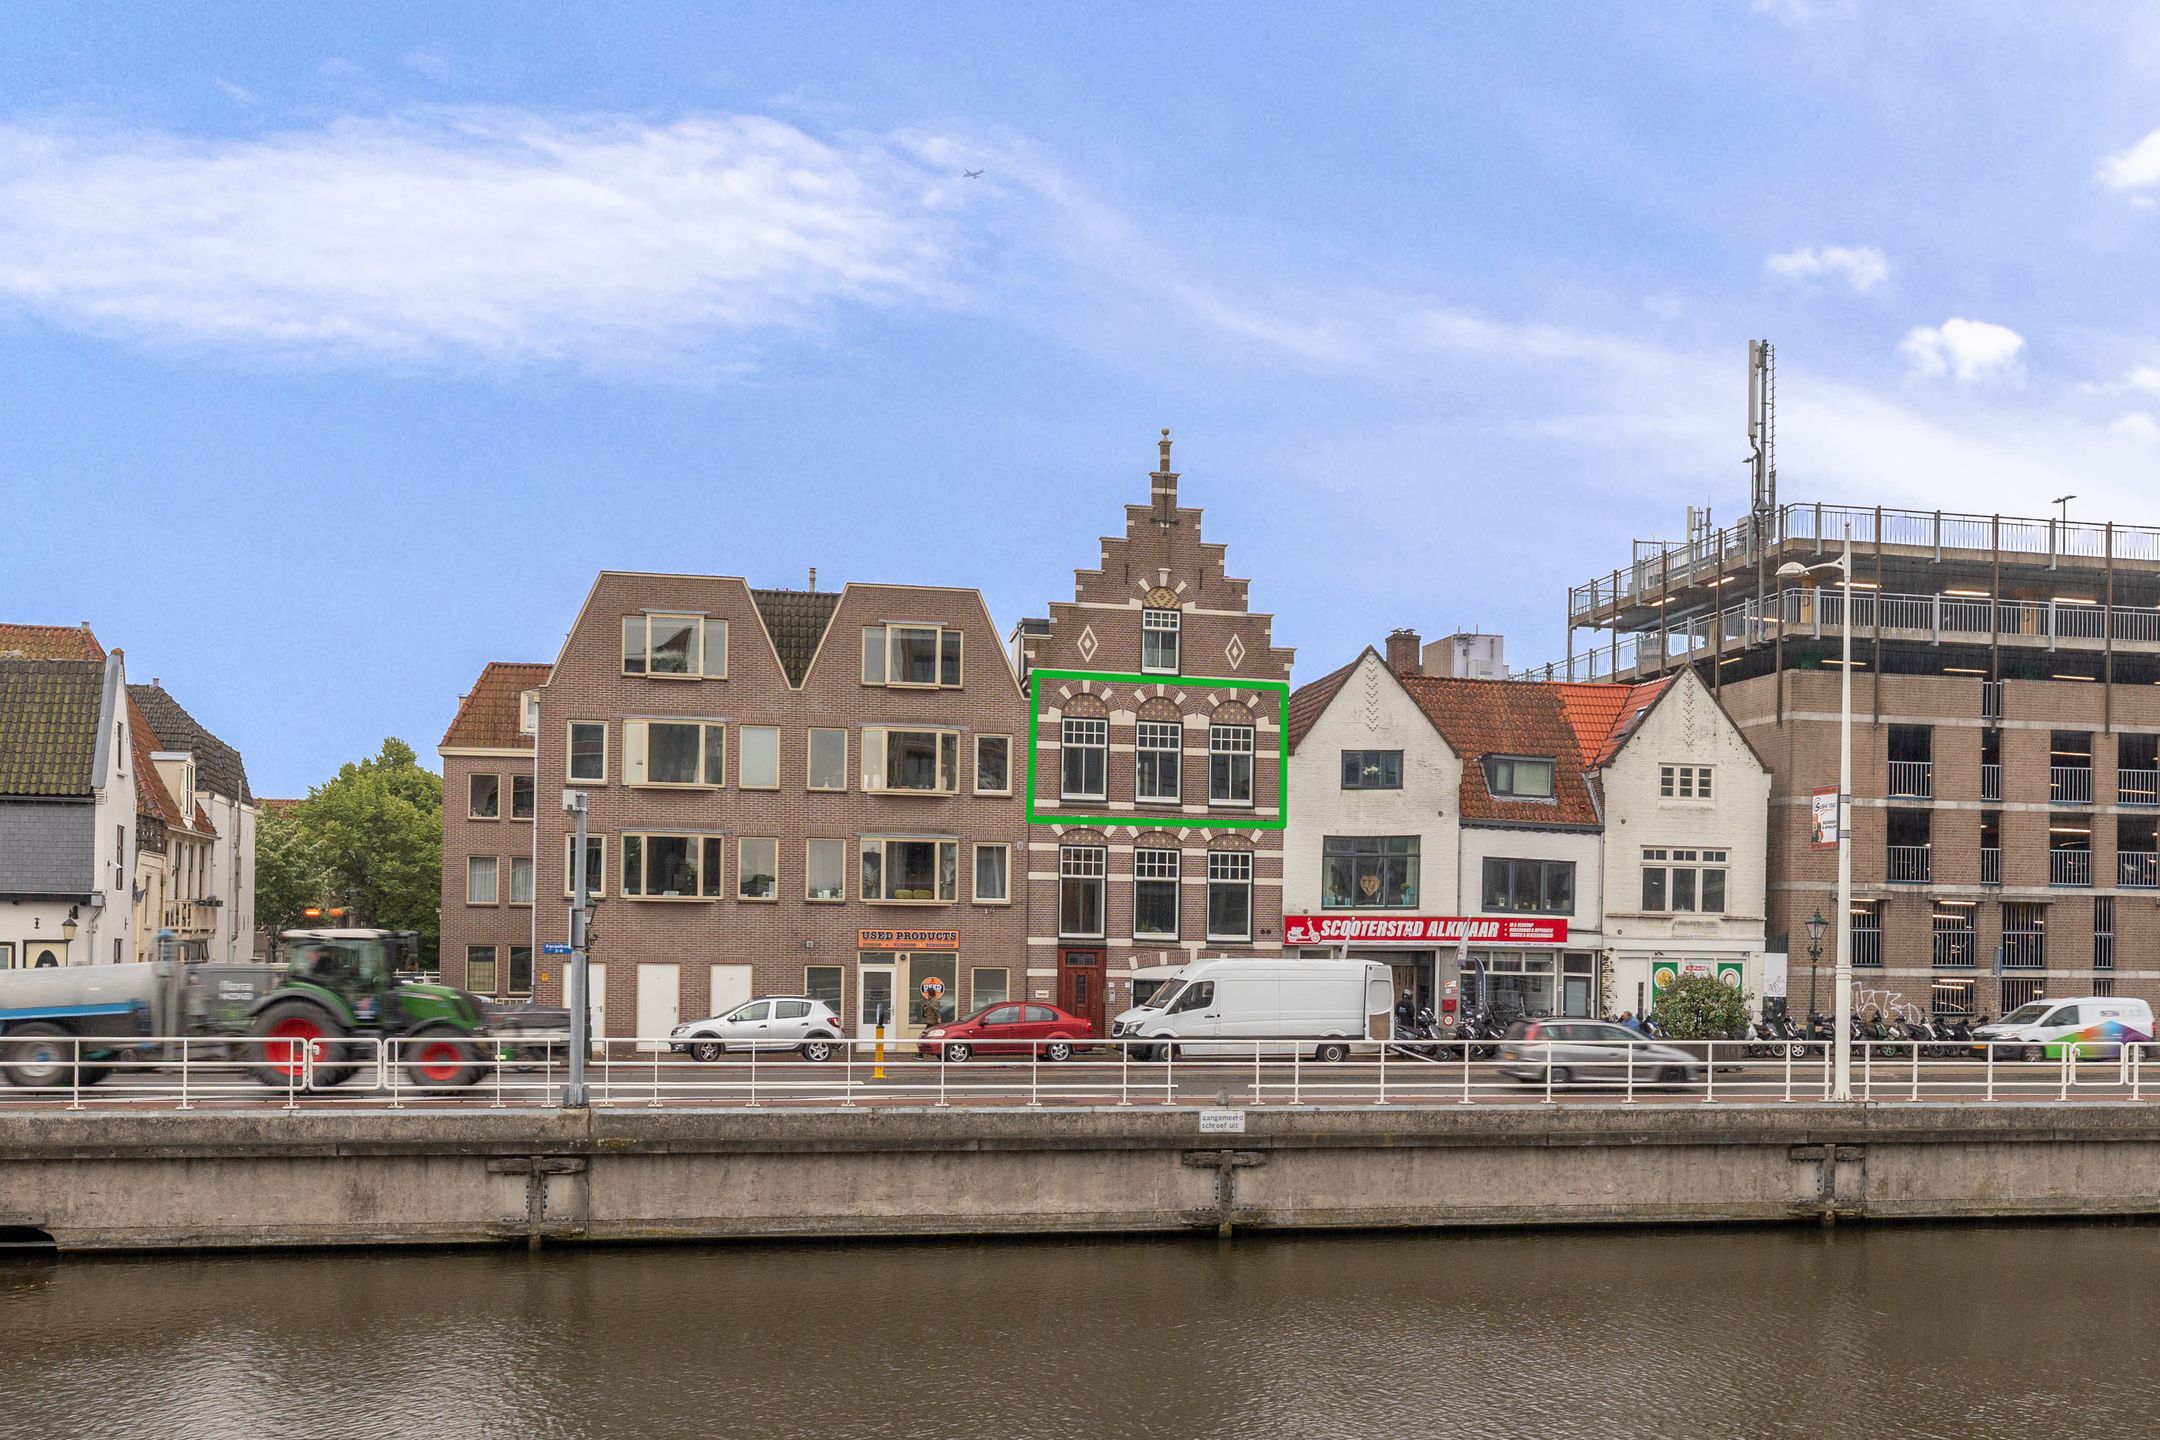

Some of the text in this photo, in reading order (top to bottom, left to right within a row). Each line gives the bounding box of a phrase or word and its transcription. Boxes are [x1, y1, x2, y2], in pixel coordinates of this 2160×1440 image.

[1320, 919, 1499, 937] SCOOTERSTAD ALKMAAR
[862, 931, 957, 941] USED PRODUCTS
[1202, 1114, 1243, 1122] aangemeerd
